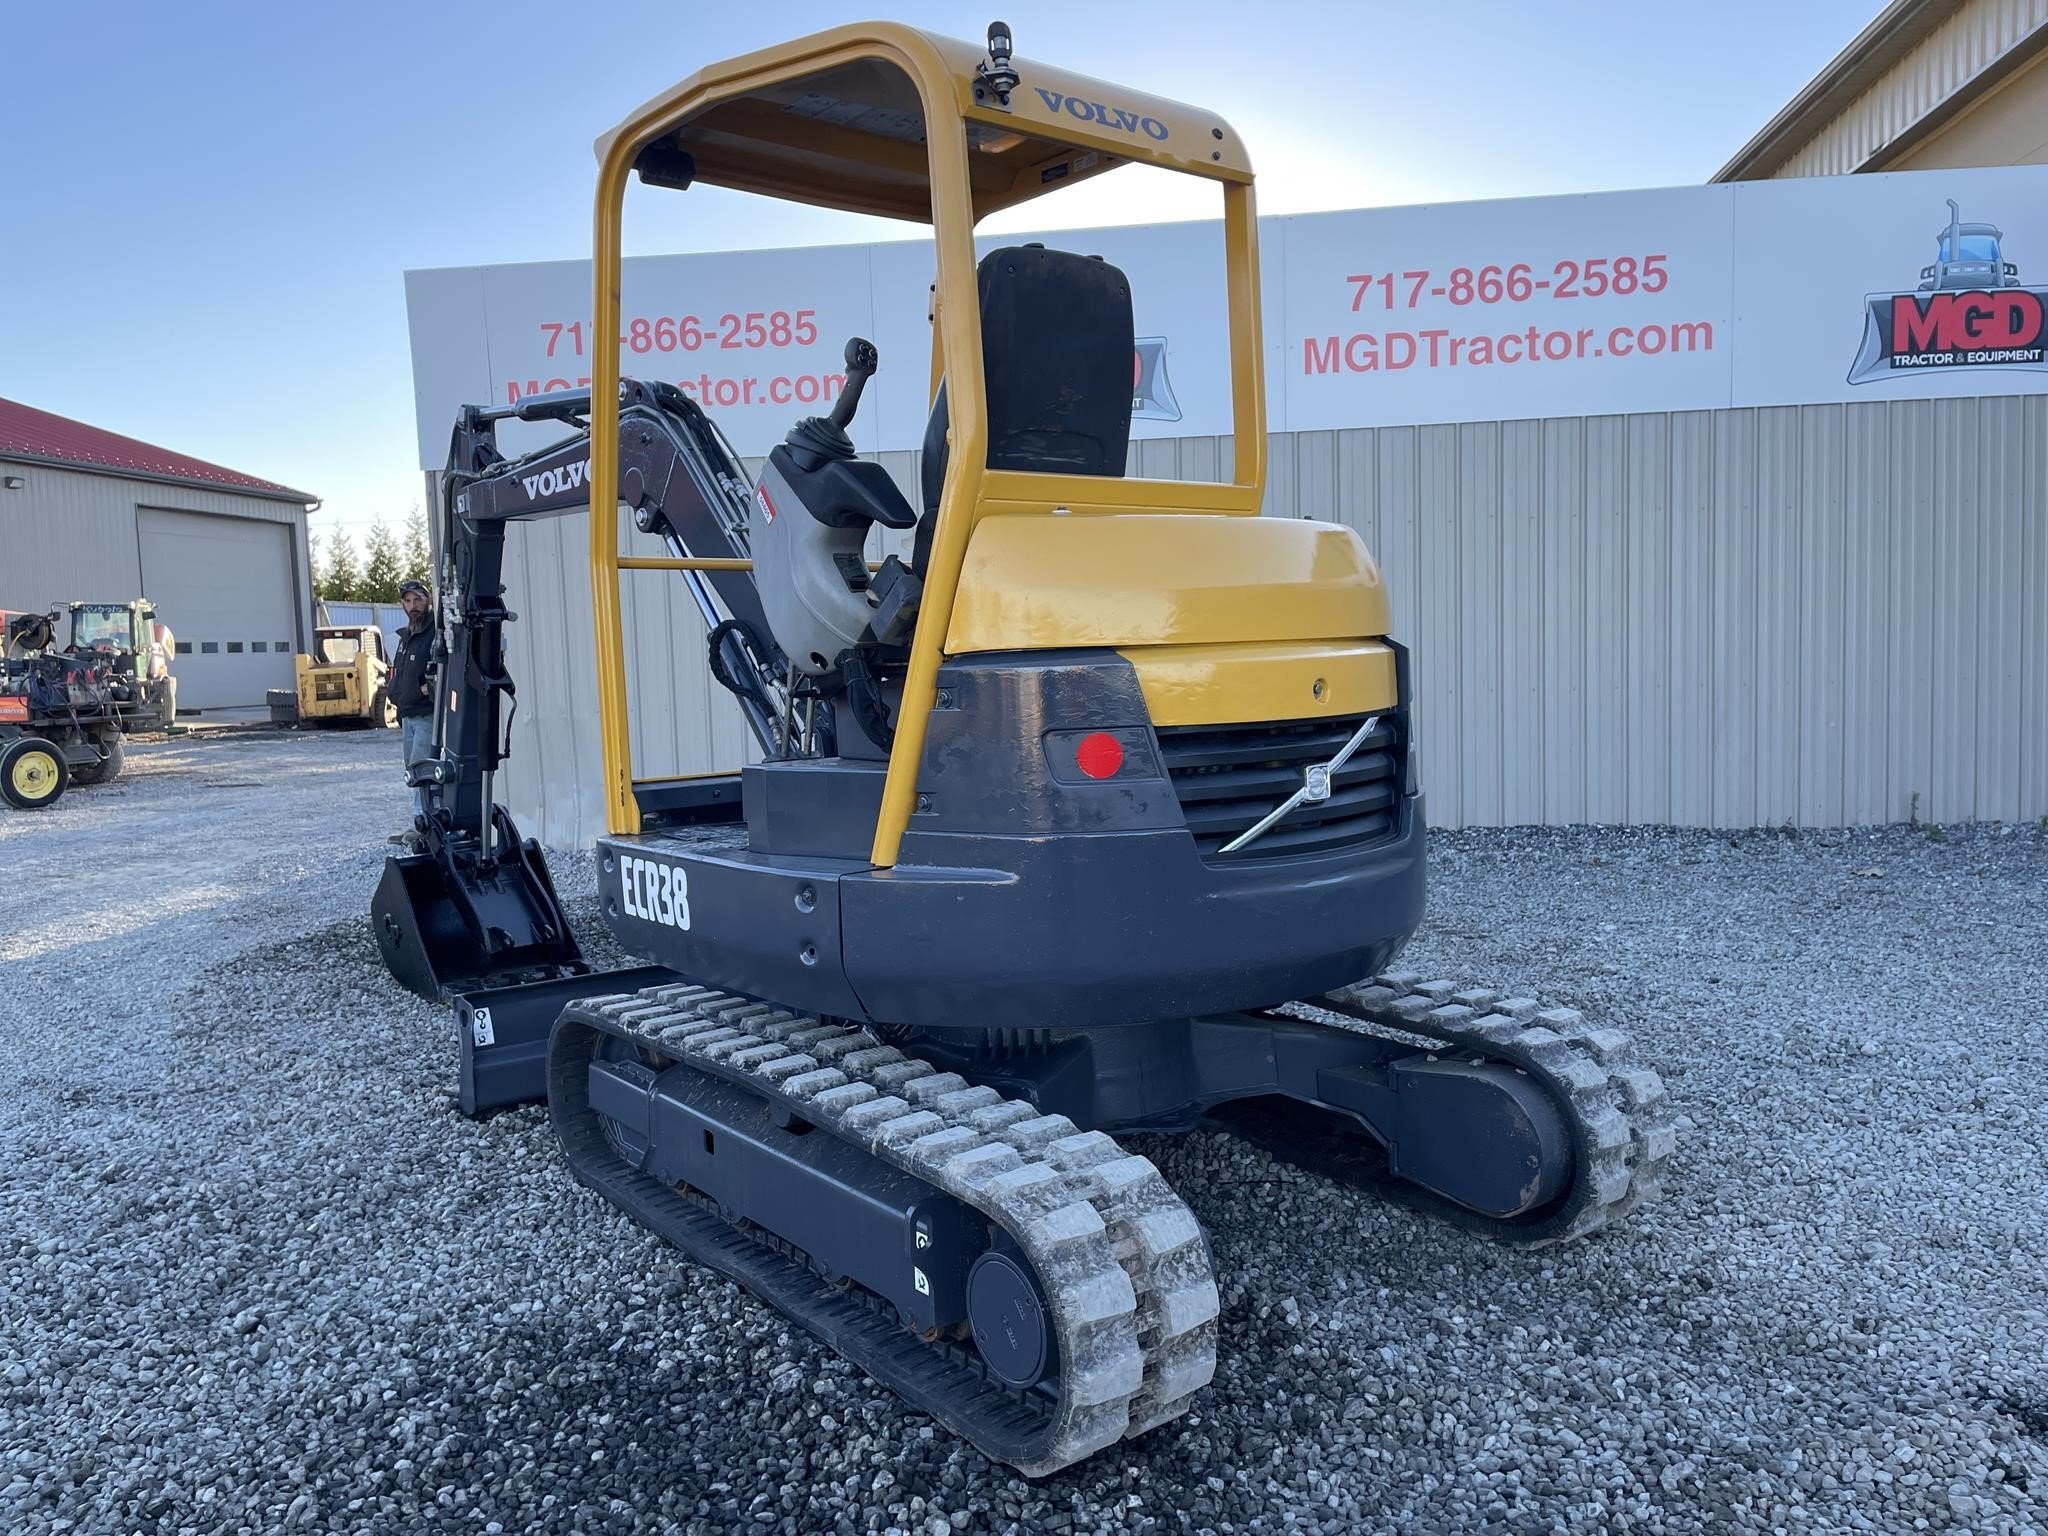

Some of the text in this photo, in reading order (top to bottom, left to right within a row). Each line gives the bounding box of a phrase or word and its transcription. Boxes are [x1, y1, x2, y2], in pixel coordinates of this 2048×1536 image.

[1034, 87, 1169, 141] VOLVO
[1346, 254, 1669, 312] 717-866-2585
[540, 310, 818, 357] 71-866-2585
[1303, 320, 1713, 375] MGDTractor.com
[1892, 290, 2043, 353] MGD
[1893, 349, 2042, 366] TRACTOR & EQUIPMENT
[522, 458, 592, 500] VOLV
[620, 855, 691, 931] ECR38
